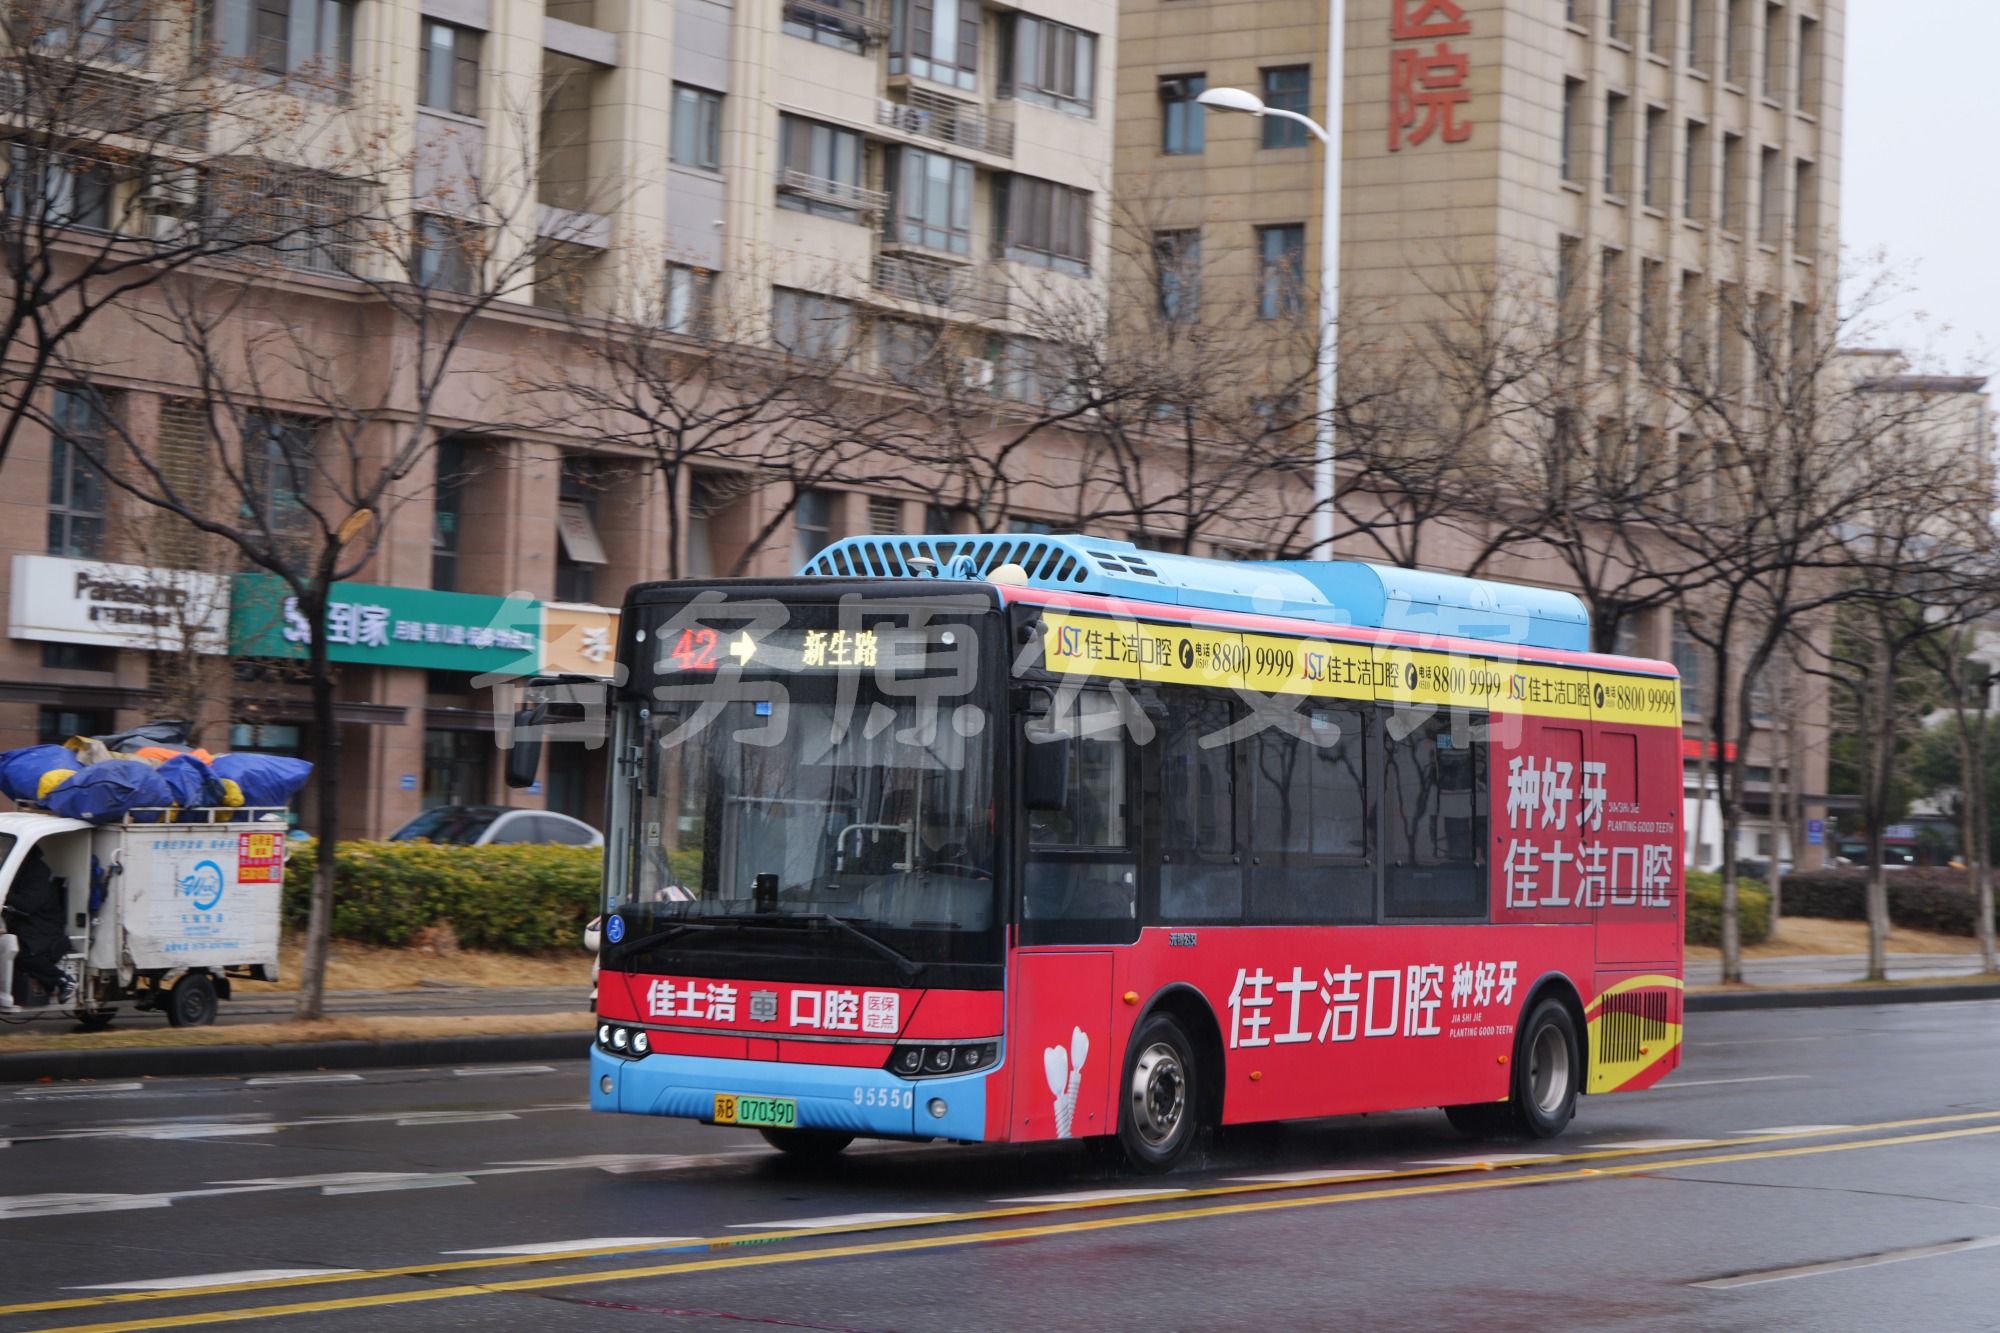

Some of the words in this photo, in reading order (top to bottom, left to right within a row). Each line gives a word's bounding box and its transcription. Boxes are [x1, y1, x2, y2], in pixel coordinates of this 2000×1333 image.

[284, 596, 392, 648] 5到家
[673, 628, 718, 671] 42
[803, 630, 878, 666] 新生路
[1053, 625, 1084, 659] JST
[1084, 629, 1173, 667] 佳士洁口腔
[1195, 641, 1211, 658] 电话
[1212, 642, 1251, 675] 8800
[1255, 648, 1293, 678] 9999
[1301, 651, 1326, 682] JST
[1326, 655, 1399, 689] 佳士洁口腔
[1418, 665, 1432, 680] 电话
[1433, 665, 1466, 695] 8800
[1469, 669, 1501, 698] 9999
[1507, 673, 1528, 702] JST
[1529, 676, 1590, 707] 佳士洁口腔
[1617, 684, 1645, 712] 8800
[1648, 689, 1676, 714] 9999
[1506, 755, 1607, 832] 种好牙
[1607, 820, 1637, 832] PLANTING
[1638, 821, 1655, 833] GOOD
[1656, 822, 1674, 834] TEETH
[1503, 838, 1673, 909] 佳士洁口腔
[646, 979, 738, 1023] 佳士洁
[789, 989, 861, 1031] 口腔
[867, 995, 896, 1011] 医保
[1451, 960, 1518, 1009] 种好牙
[867, 1012, 895, 1030] 定点
[1228, 963, 1444, 1050] 佳士洁口腔
[1451, 1013, 1461, 1024] JIA
[1462, 1012, 1472, 1023] SHI
[1473, 1011, 1482, 1022] JIE
[1450, 1027, 1477, 1038] PLANTING
[1478, 1025, 1495, 1037] GOOD
[1495, 1024, 1514, 1035] TEETH
[854, 1086, 913, 1110] 95550
